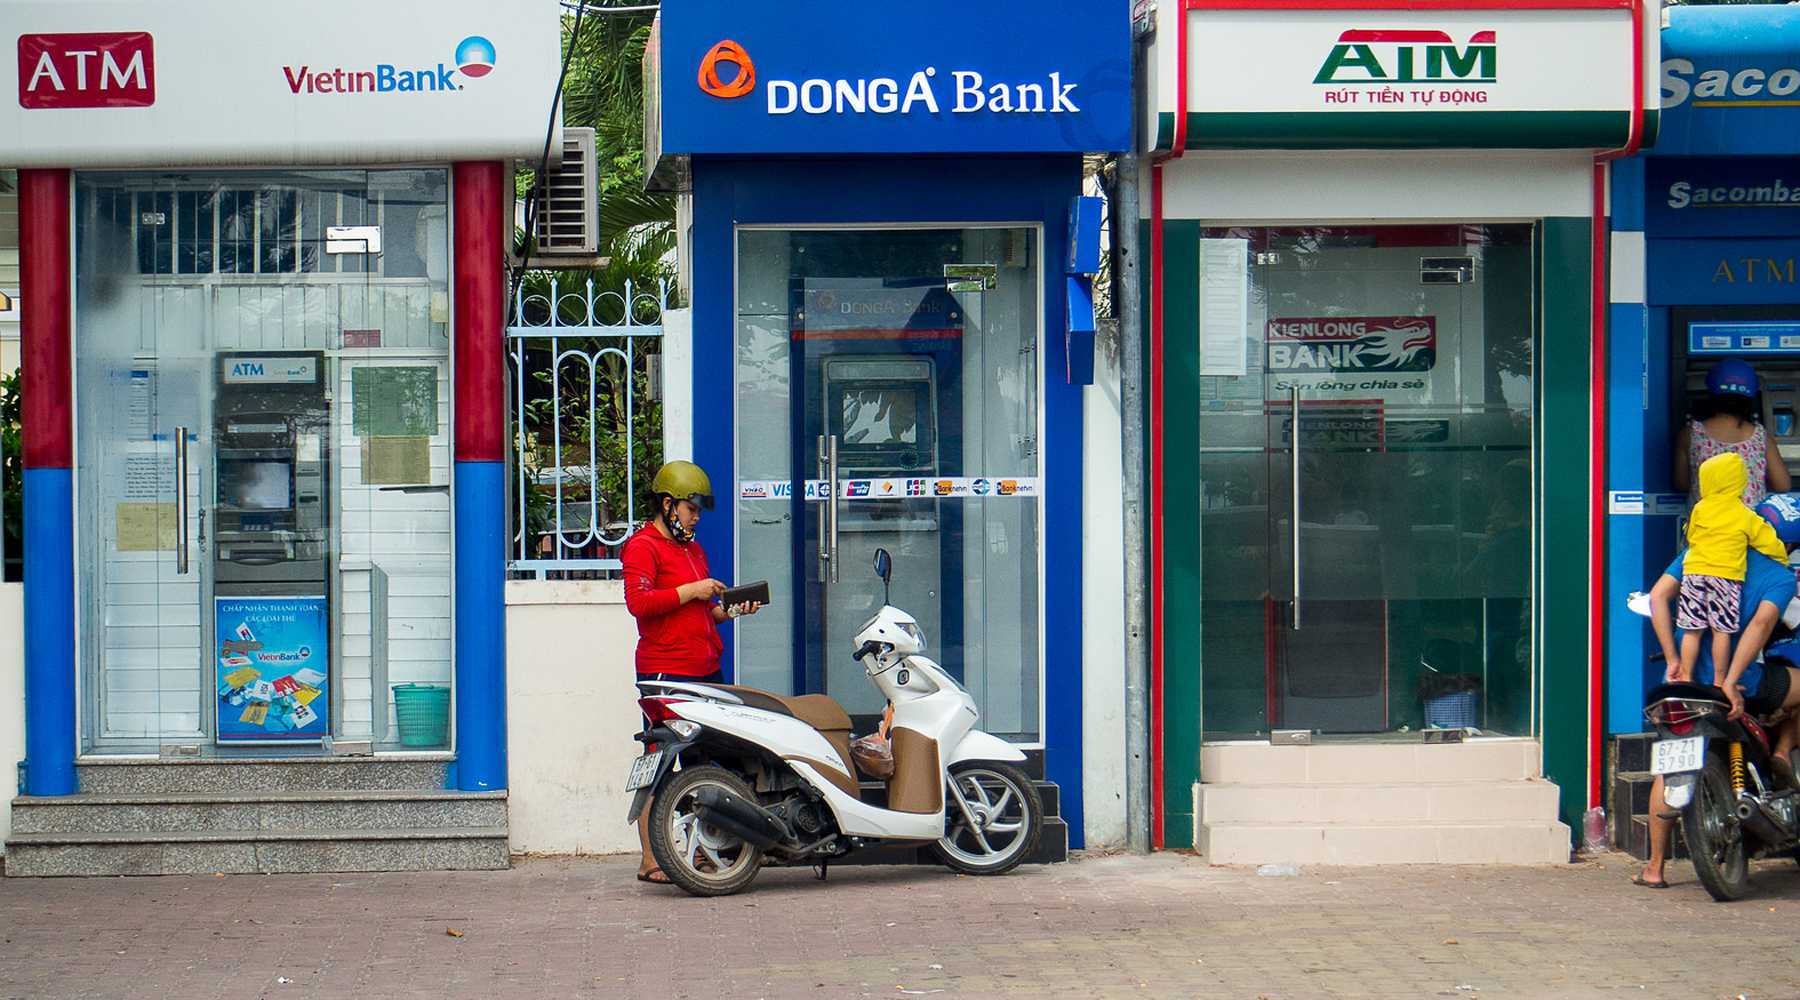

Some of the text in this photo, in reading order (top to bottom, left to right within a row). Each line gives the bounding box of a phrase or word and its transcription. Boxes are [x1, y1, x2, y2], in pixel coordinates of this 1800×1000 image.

[1312, 29, 1496, 83] ATM
[26, 50, 147, 91] ATM
[282, 64, 458, 93] VietinBank
[951, 70, 1080, 113] Bank
[1325, 87, 1487, 105] RÚT TIỀN TỰ ĐỘNG
[1660, 58, 1800, 109] Saco
[1712, 258, 1794, 283] ATM
[1269, 323, 1366, 337] KIENLONG
[1269, 345, 1365, 368] BANK
[232, 363, 264, 376] ATM
[1360, 380, 1397, 389] chia
